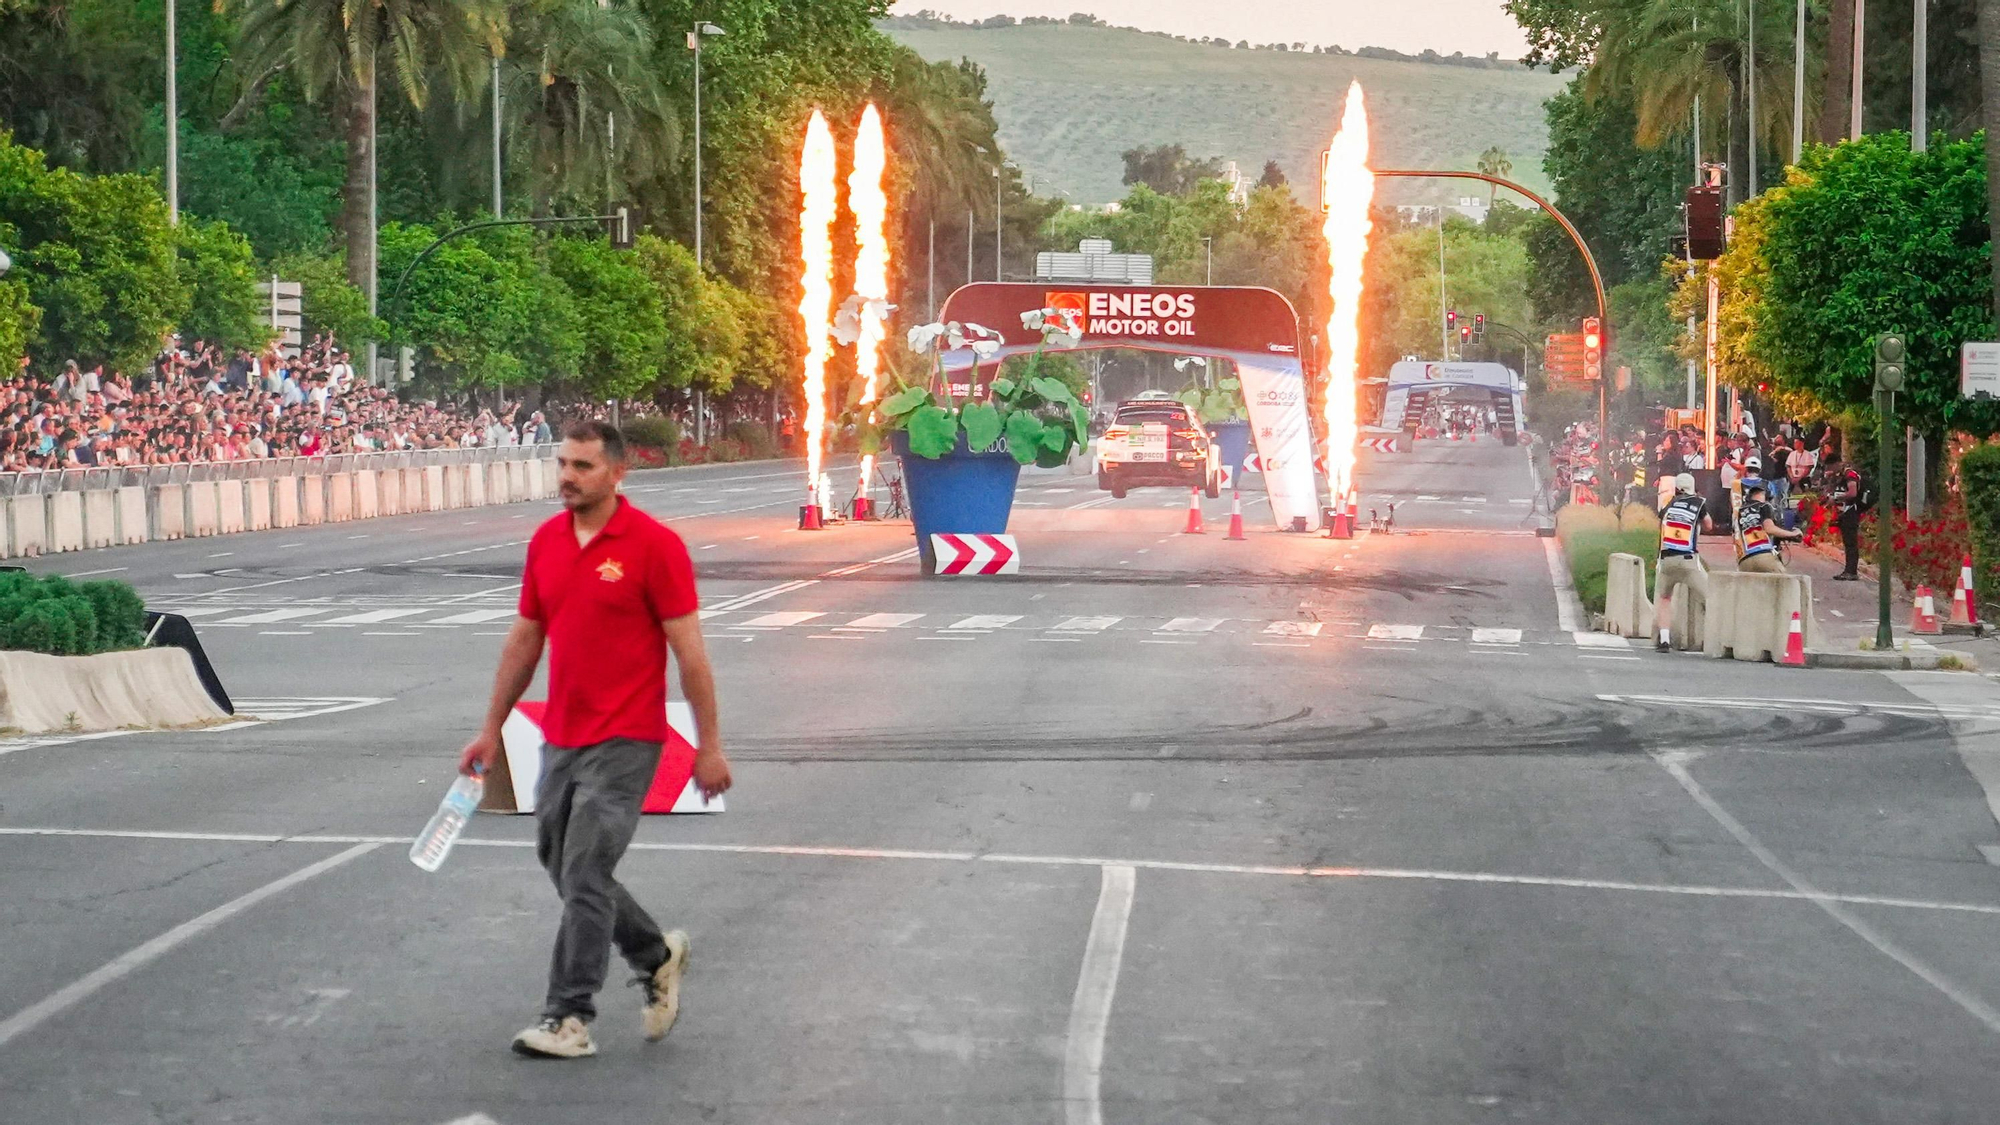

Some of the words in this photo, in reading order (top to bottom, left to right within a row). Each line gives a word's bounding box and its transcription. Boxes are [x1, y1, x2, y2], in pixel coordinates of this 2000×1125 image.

[1089, 292, 1195, 318] ENEOS
[1089, 319, 1159, 335] MOTOR
[1164, 320, 1195, 336] OIL
